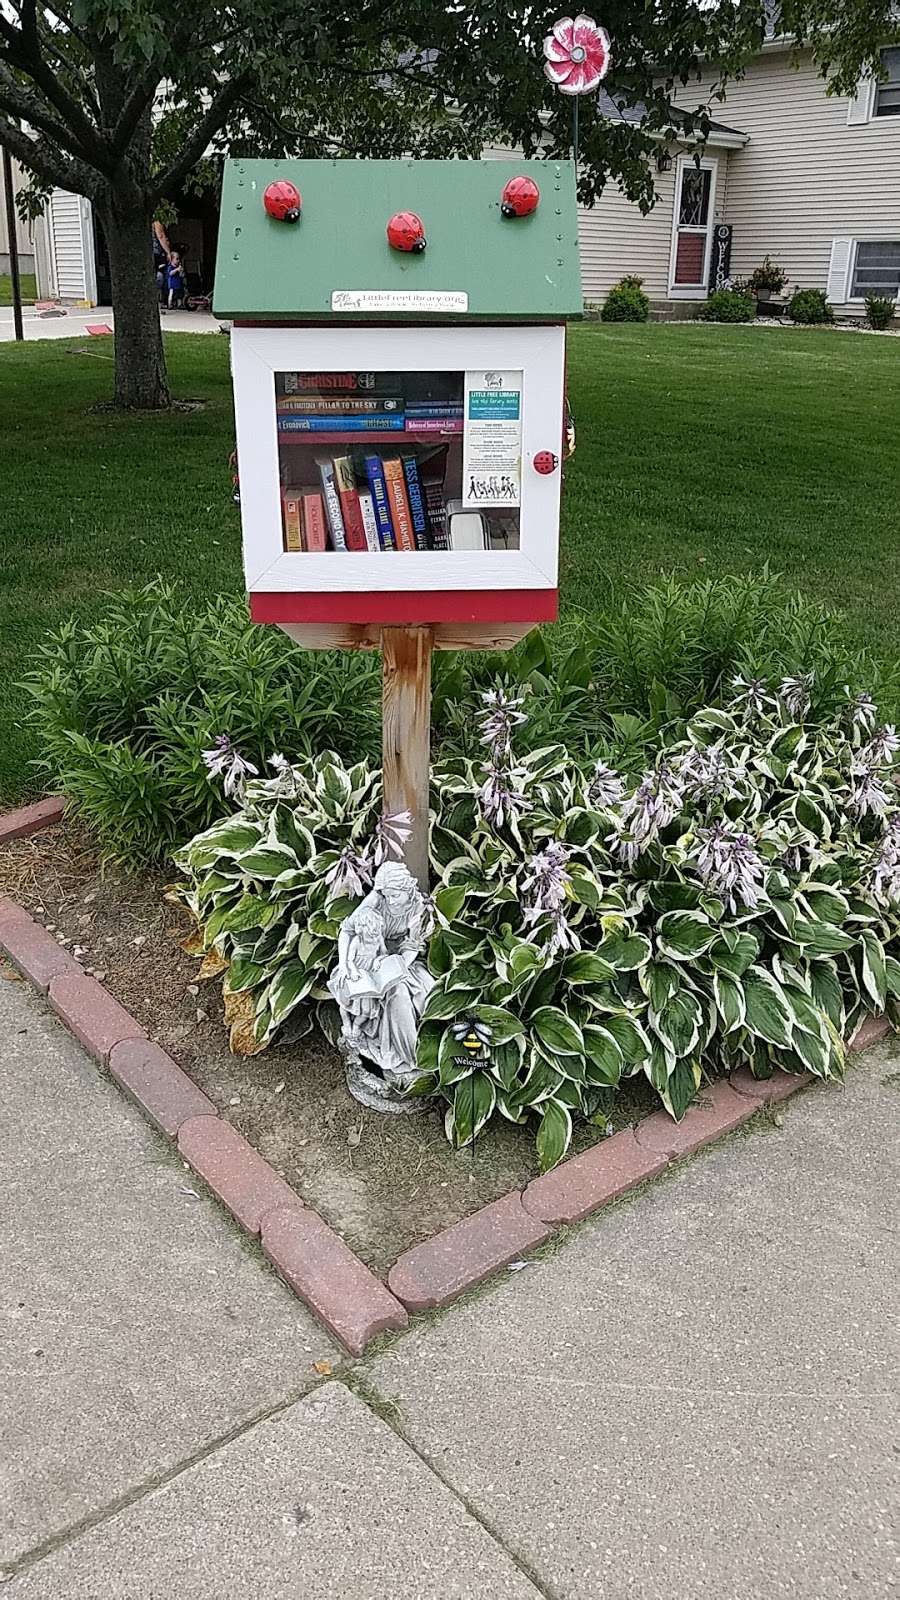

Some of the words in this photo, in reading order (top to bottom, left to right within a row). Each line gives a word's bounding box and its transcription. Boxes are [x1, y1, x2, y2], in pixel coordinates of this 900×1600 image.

[716, 241, 729, 292] WELCOM
[318, 401, 340, 409] PILLAR
[363, 401, 377, 409] SKY
[405, 458, 418, 482] TESS
[325, 480, 337, 499] THE
[328, 498, 344, 530] SECOND
[393, 480, 404, 514] LAURELL
[400, 522, 412, 551] HAMILTO
[408, 483, 426, 532] GERRITSEN
[334, 530, 346, 549] CITY
[454, 1056, 489, 1067] Welcome
